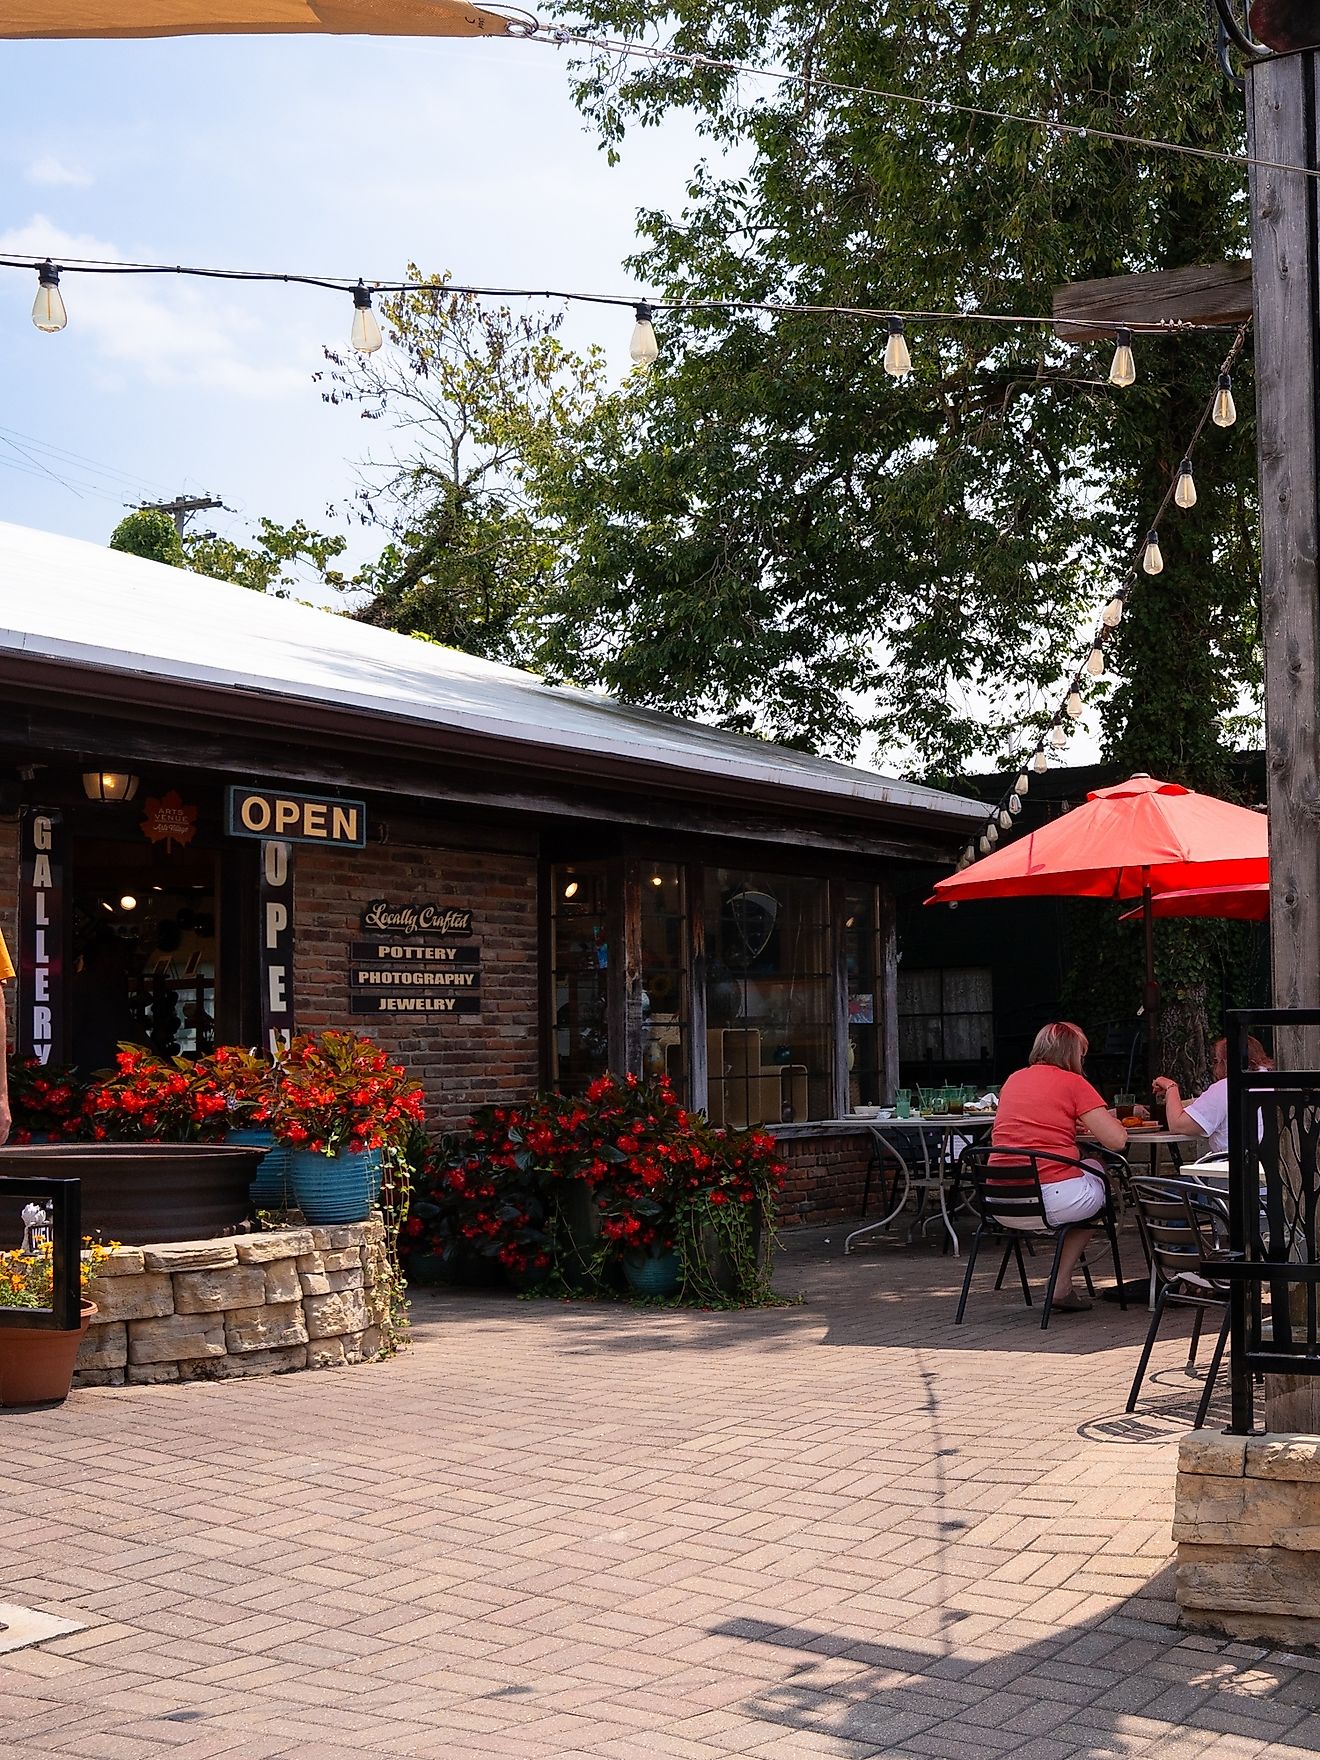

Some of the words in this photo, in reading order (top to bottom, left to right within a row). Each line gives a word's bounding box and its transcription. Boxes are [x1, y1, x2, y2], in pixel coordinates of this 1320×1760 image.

[240, 795, 358, 841] OPEN
[365, 903, 418, 934] Locally
[419, 906, 470, 934] Crafted
[32, 815, 53, 1066] GALLERY
[378, 945, 457, 960] POTTERY
[358, 971, 475, 985] PHOTOGRAPHY
[378, 998, 456, 1010] JEWELRY
